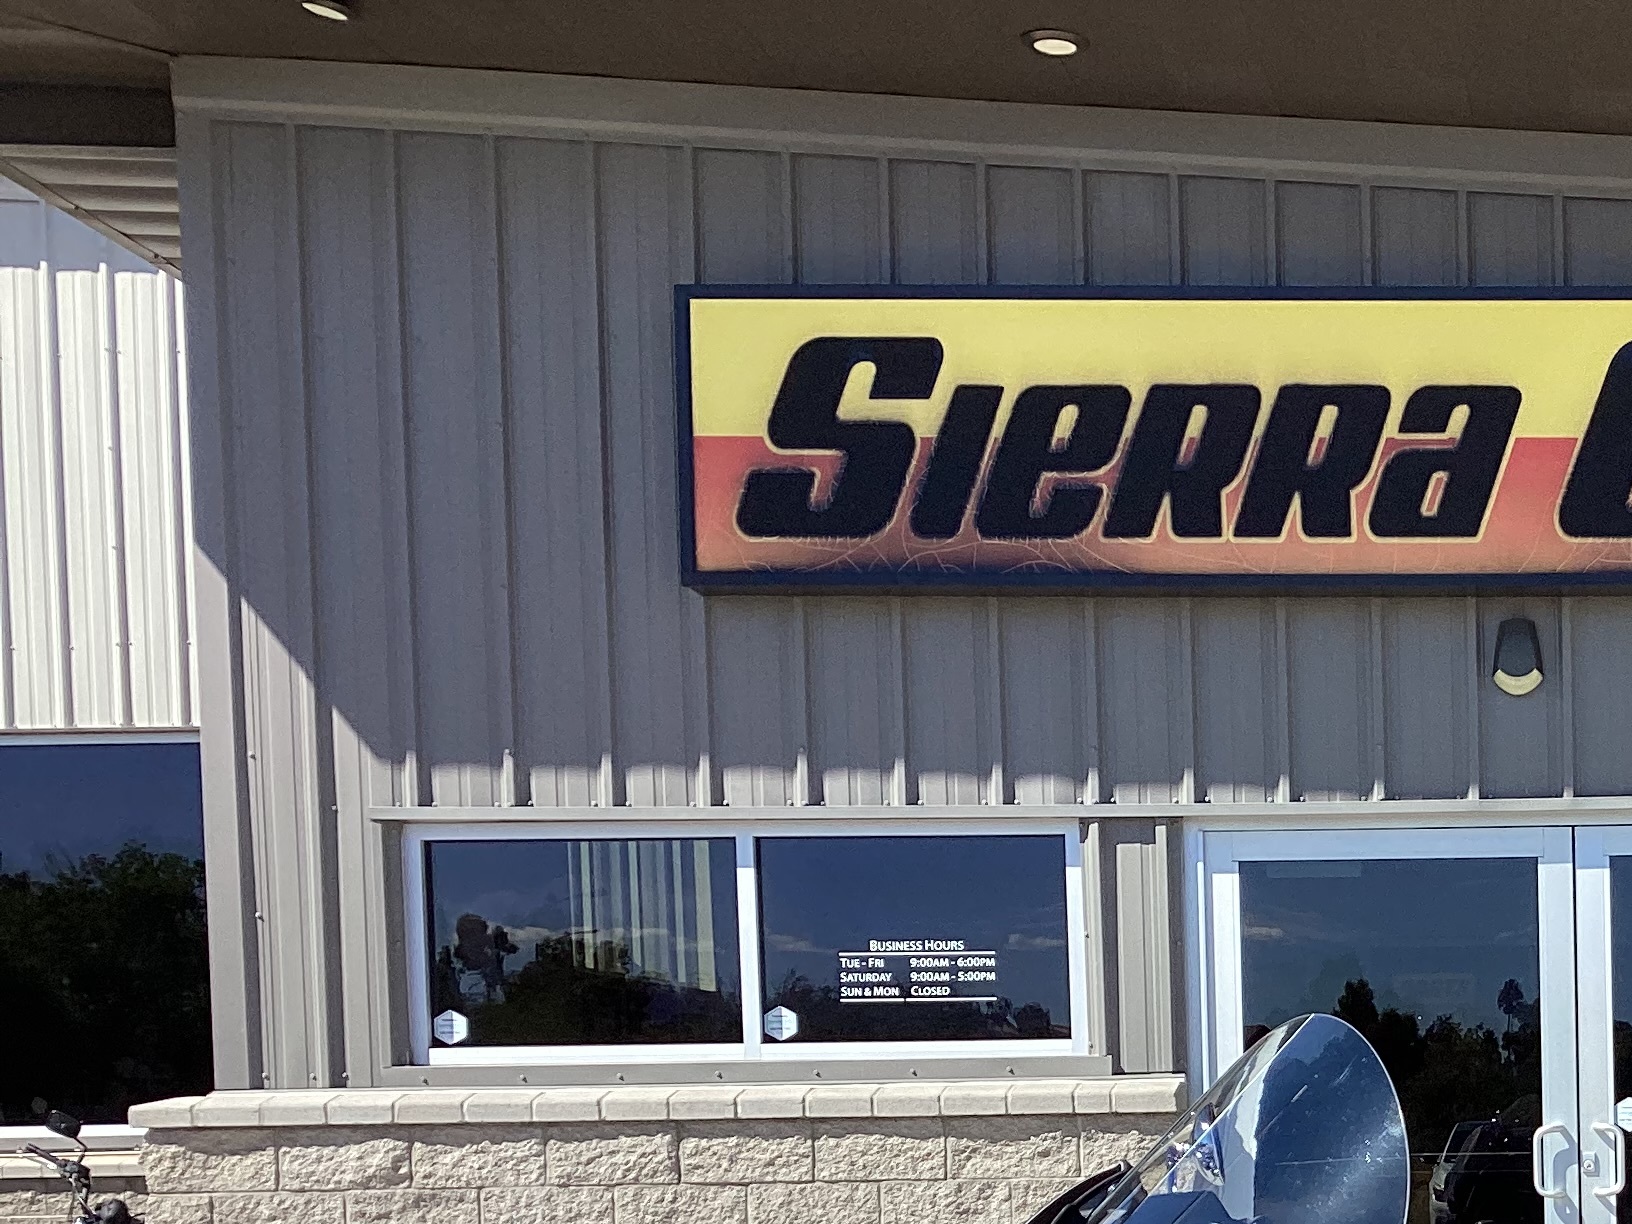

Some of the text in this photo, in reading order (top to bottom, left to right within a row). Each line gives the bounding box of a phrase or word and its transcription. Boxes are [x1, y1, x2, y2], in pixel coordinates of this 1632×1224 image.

[909, 957, 949, 968] 9:00AM
[957, 956, 995, 967] 6:00PM
[909, 971, 950, 982] 9:00AM
[957, 971, 996, 981] 5:00PM
